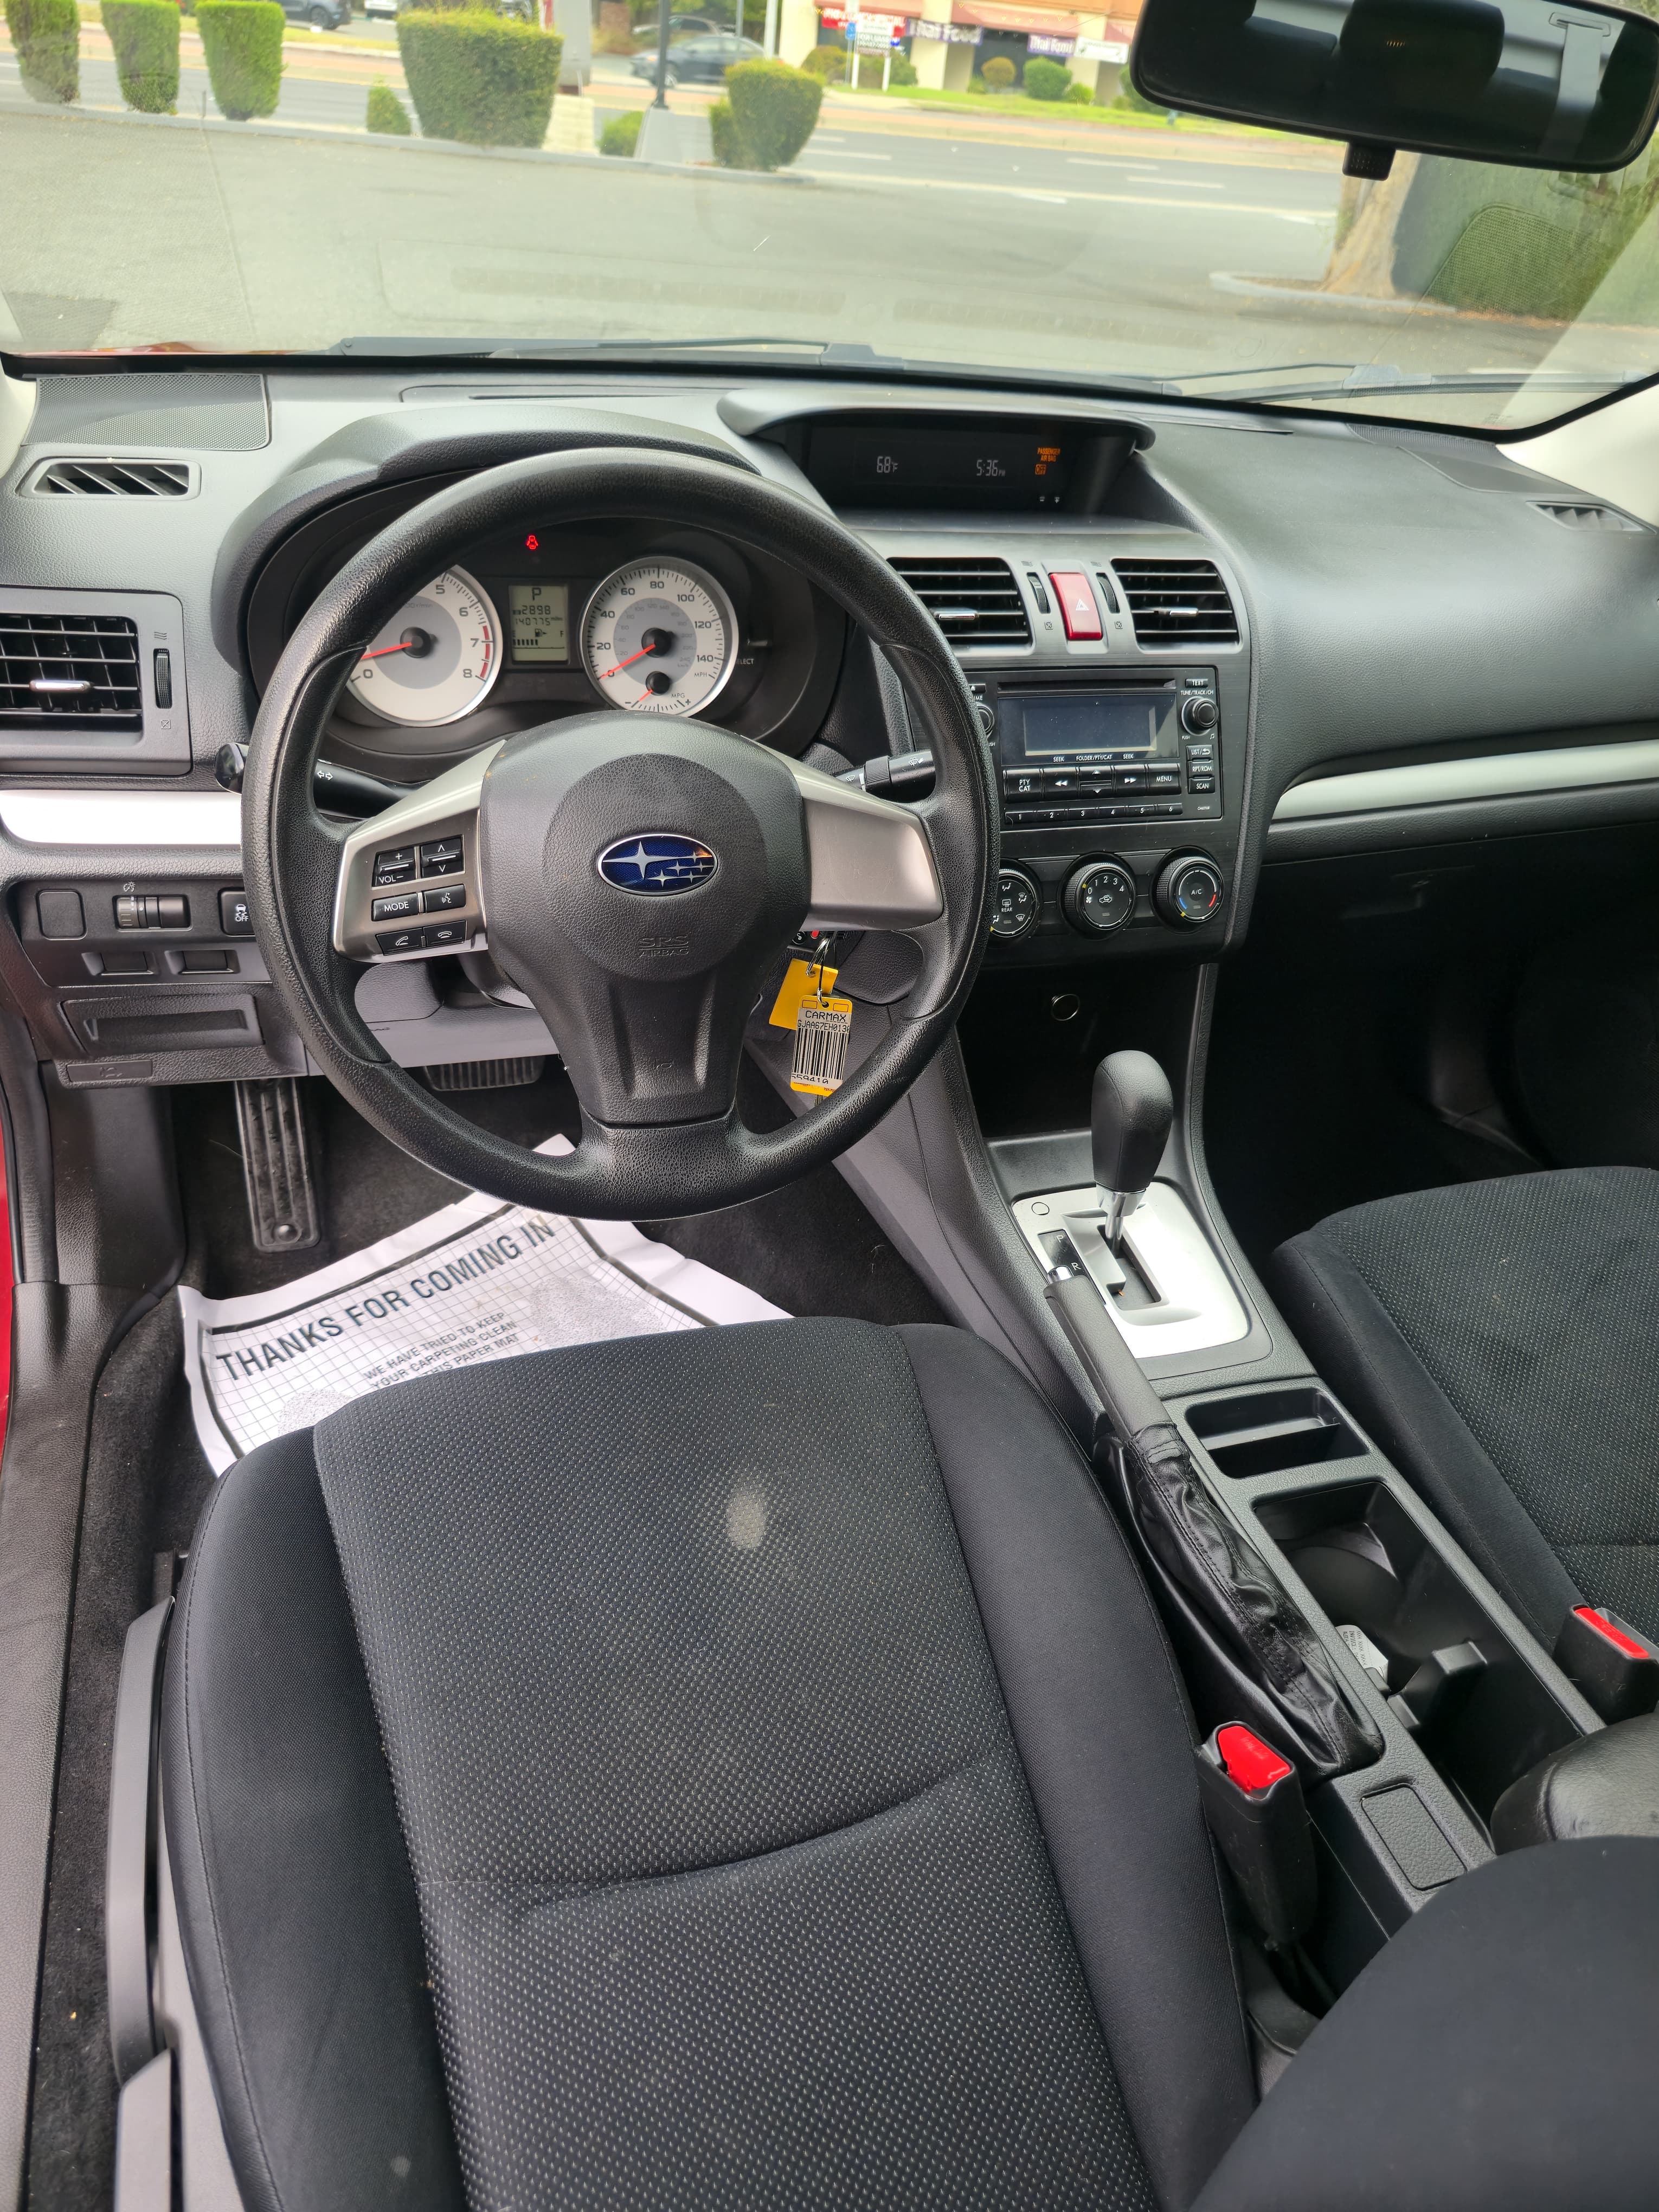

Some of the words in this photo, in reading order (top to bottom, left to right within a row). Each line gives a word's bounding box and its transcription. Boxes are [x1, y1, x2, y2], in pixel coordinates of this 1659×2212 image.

[436, 584, 445, 594] 5
[532, 587, 542, 601] P
[460, 608, 468, 617] 6
[522, 605, 551, 615] 2898
[516, 618, 550, 626] 140775
[695, 621, 711, 629] 120
[471, 639, 479, 647] 7
[697, 654, 713, 663] 140
[364, 669, 373, 678] 0
[464, 669, 472, 678] 8
[379, 876, 396, 884] VOL
[384, 901, 409, 912] MODE
[640, 935, 690, 948] SRS
[639, 949, 690, 958] AIRBAG
[805, 1010, 846, 1023] CARMAX
[1056, 1234, 1065, 1243] P
[1071, 1262, 1082, 1270] R
[216, 1316, 344, 1381] THANKS
[344, 1290, 411, 1327] FOR
[410, 1234, 523, 1298] COMING
[520, 1214, 556, 1248] IN
[363, 1365, 387, 1380] WE
[386, 1347, 421, 1369] HAVE
[420, 1333, 458, 1351] TRIED
[457, 1324, 476, 1336] TO
[476, 1312, 505, 1329] KEEP
[453, 1345, 494, 1365] PAPER
[494, 1333, 520, 1349] MAT
[371, 1369, 409, 1389] YOUR
[409, 1338, 478, 1373] CARPETING
[478, 1320, 518, 1341] CLEAN
